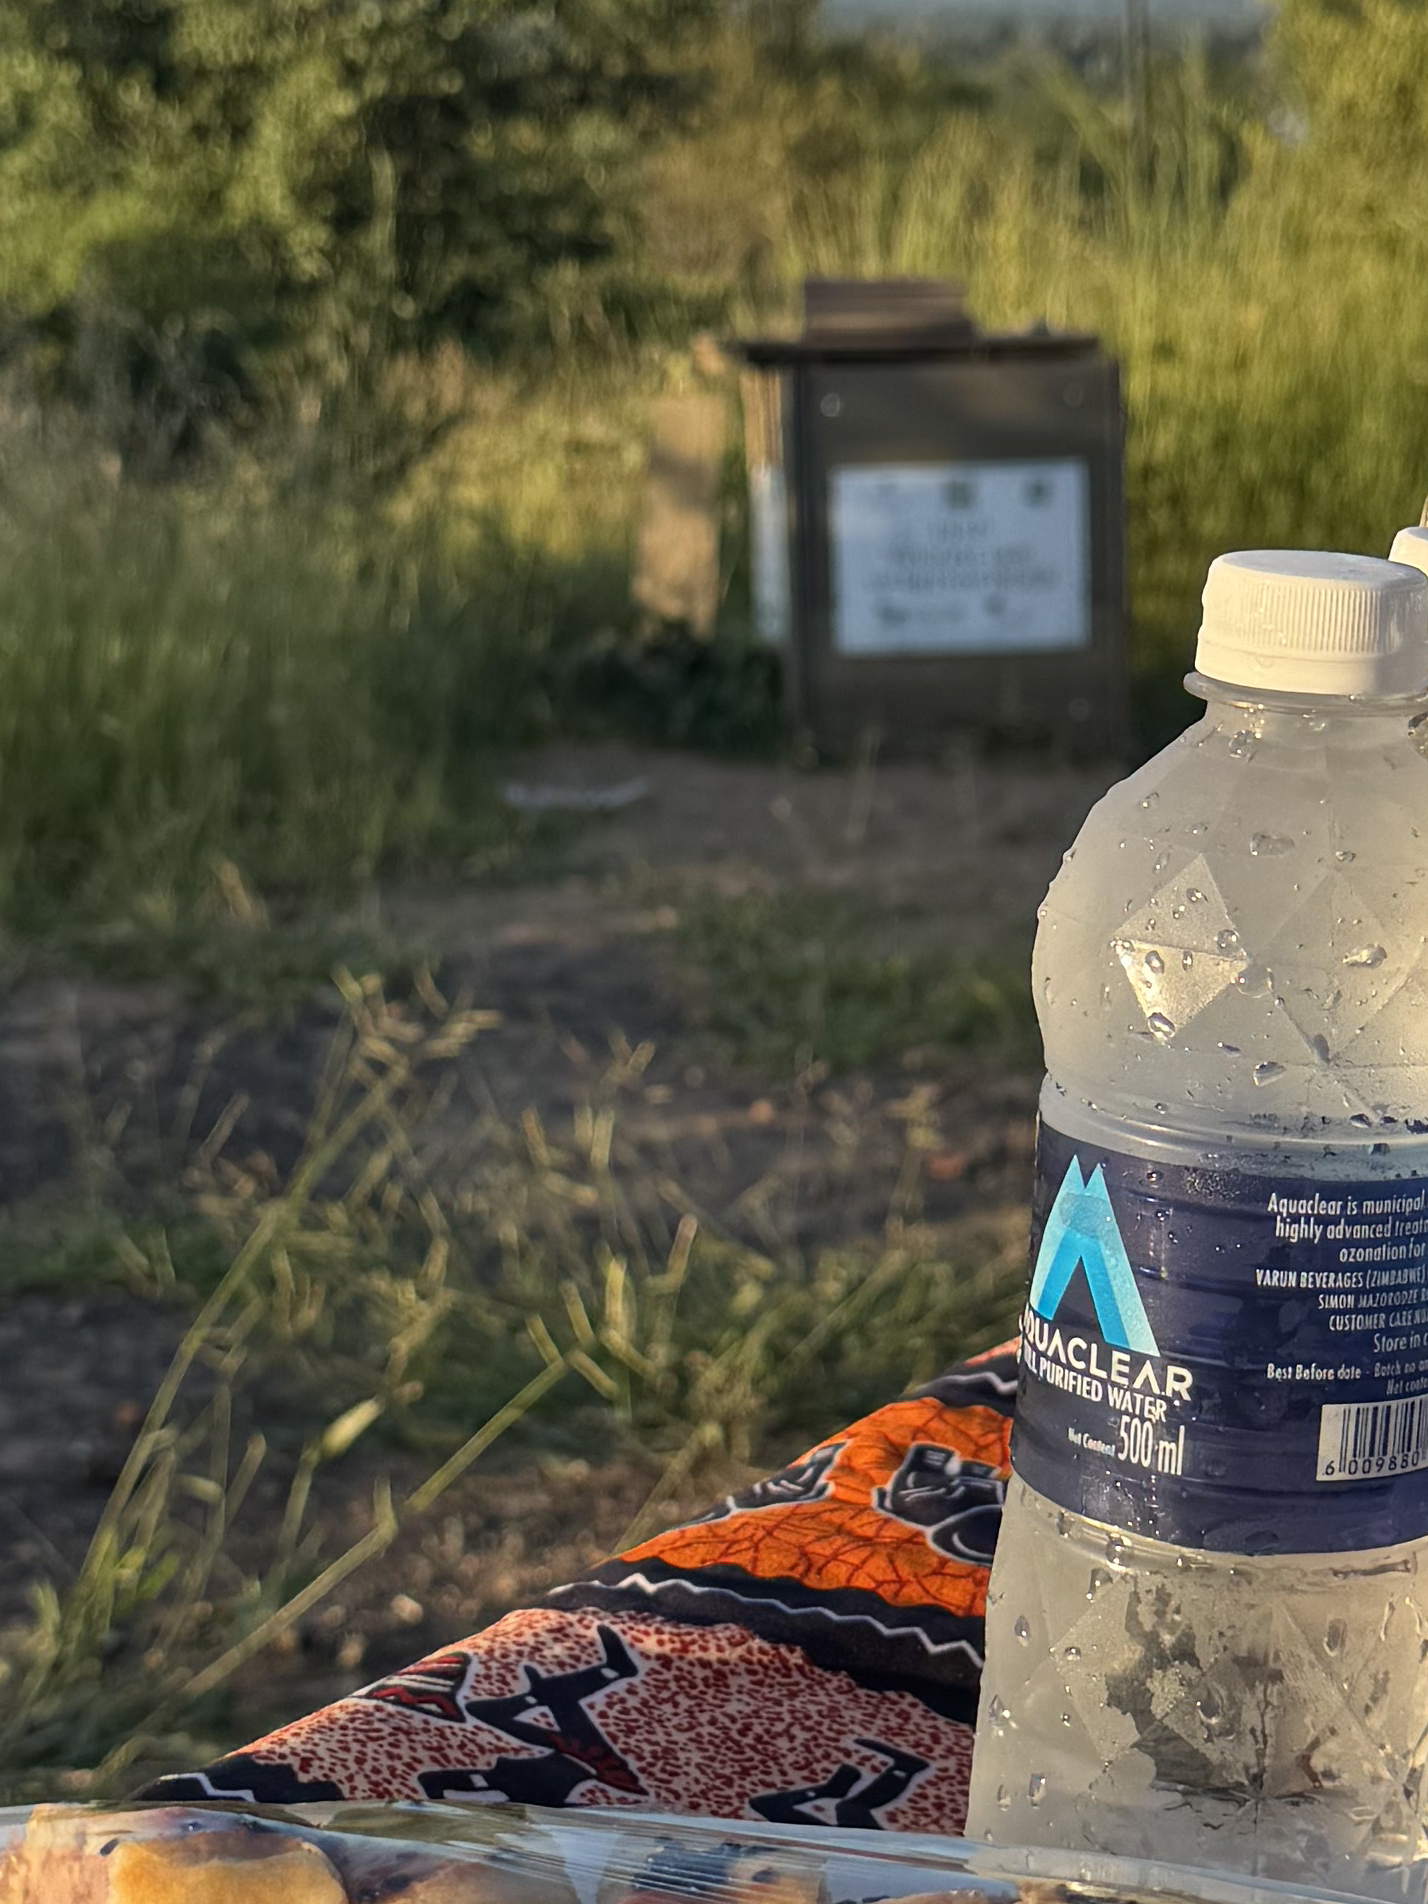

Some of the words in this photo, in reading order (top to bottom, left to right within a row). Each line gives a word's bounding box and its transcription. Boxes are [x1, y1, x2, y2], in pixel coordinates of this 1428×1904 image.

[1267, 1193, 1342, 1216] Aquaclear
[1347, 1196, 1357, 1215] is
[1275, 1215, 1323, 1244] highly
[1326, 1216, 1391, 1239] advanced
[1339, 1243, 1407, 1263] ozonation
[1256, 1268, 1296, 1288] VARUN
[1300, 1270, 1363, 1289] BEVERAGES
[1318, 1293, 1355, 1310] SIMON
[1329, 1313, 1385, 1331] CUSTOMER
[1373, 1333, 1407, 1353] Store
[1410, 1329, 1421, 1349] in
[1267, 1362, 1292, 1381] Best
[1296, 1363, 1334, 1380] Before
[1338, 1364, 1362, 1380] date
[1039, 1356, 1103, 1402] PURIFIED
[1107, 1383, 1167, 1422] WATER
[1118, 1415, 1154, 1468] 500
[1157, 1425, 1185, 1476] ml
